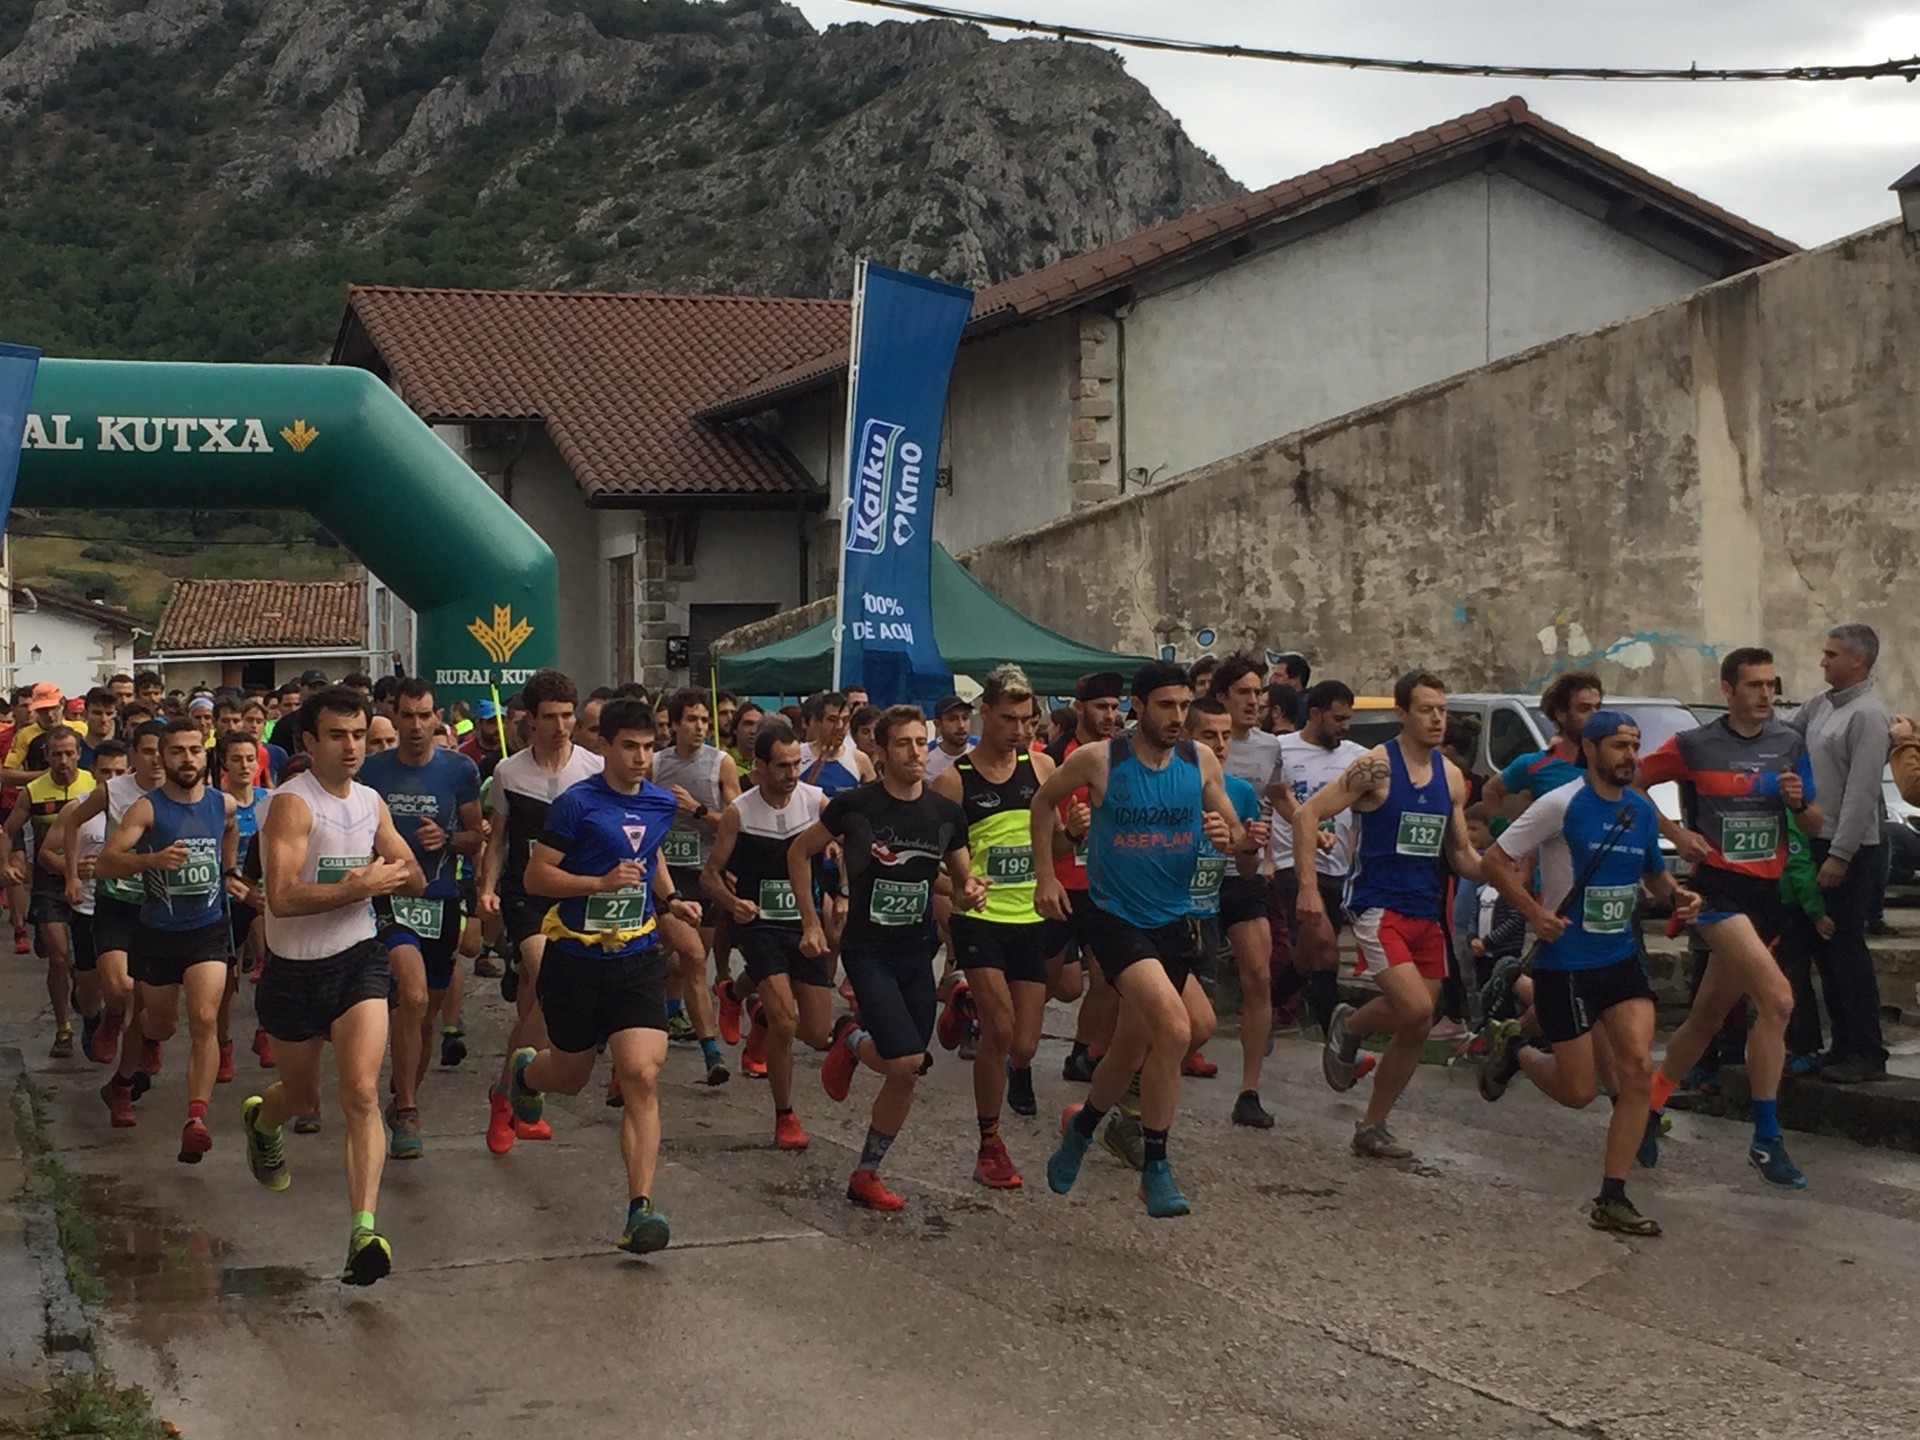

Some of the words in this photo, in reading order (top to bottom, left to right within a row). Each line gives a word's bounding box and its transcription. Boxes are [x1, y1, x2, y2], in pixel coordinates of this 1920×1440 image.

[97, 416, 274, 453] KUTXA
[856, 433, 888, 543] Kaiku
[861, 591, 905, 616] 100%
[852, 620, 876, 640] DE
[1112, 831, 1193, 848] ASEPLAN
[1409, 826, 1437, 844] 132
[1734, 831, 1769, 850] 210
[664, 841, 691, 856] 218
[177, 865, 210, 884] 100
[998, 857, 1030, 875] 199
[604, 899, 631, 919] 27
[881, 895, 919, 913] 224
[1602, 901, 1625, 921] 90
[401, 906, 432, 925] 150
